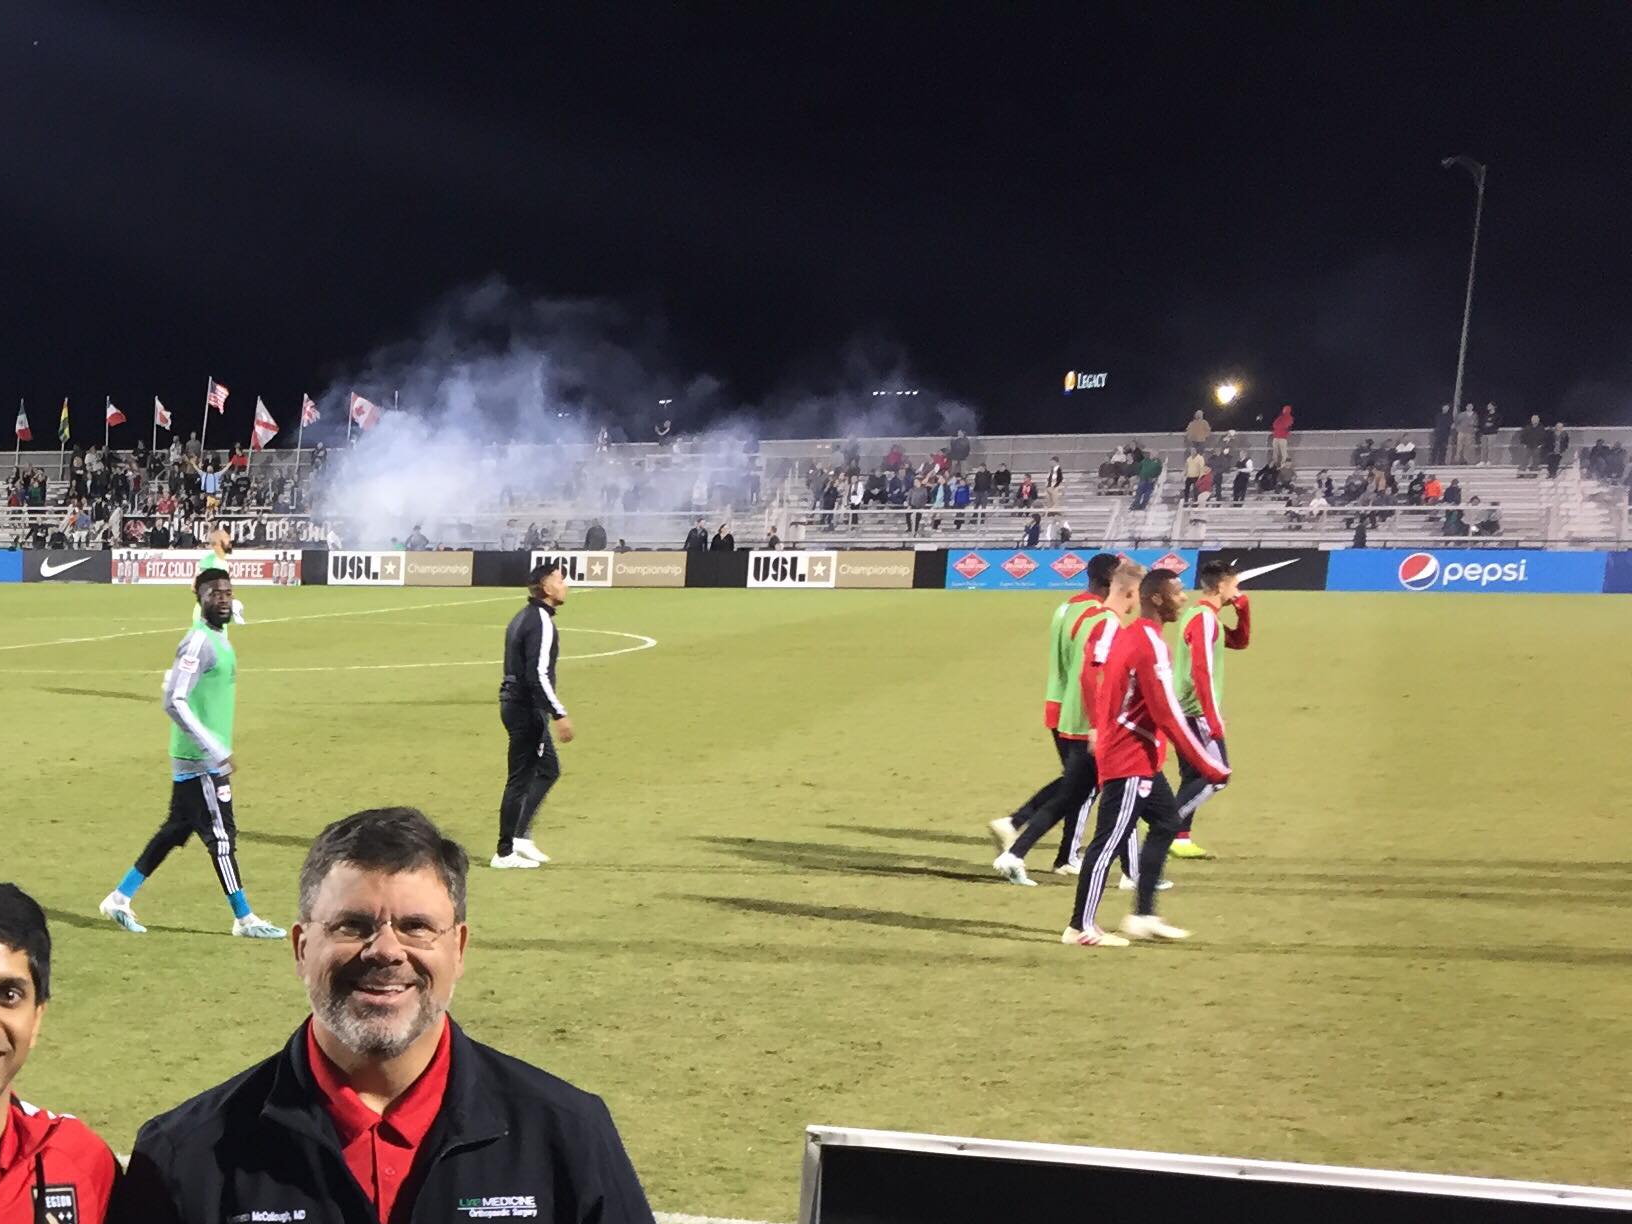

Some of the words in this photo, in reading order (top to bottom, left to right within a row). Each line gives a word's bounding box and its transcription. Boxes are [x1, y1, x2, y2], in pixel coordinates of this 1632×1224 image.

[168, 561, 194, 577] COLD
[227, 561, 264, 578] COFFEE
[332, 555, 379, 580] USL
[407, 562, 470, 576] Championship
[616, 562, 682, 577] Championship
[752, 556, 806, 583] USL
[838, 562, 911, 577] Championship
[1442, 558, 1527, 586] pepsi
[45, 1195, 72, 1208] EGION
[482, 1196, 536, 1207] MEDICINE
